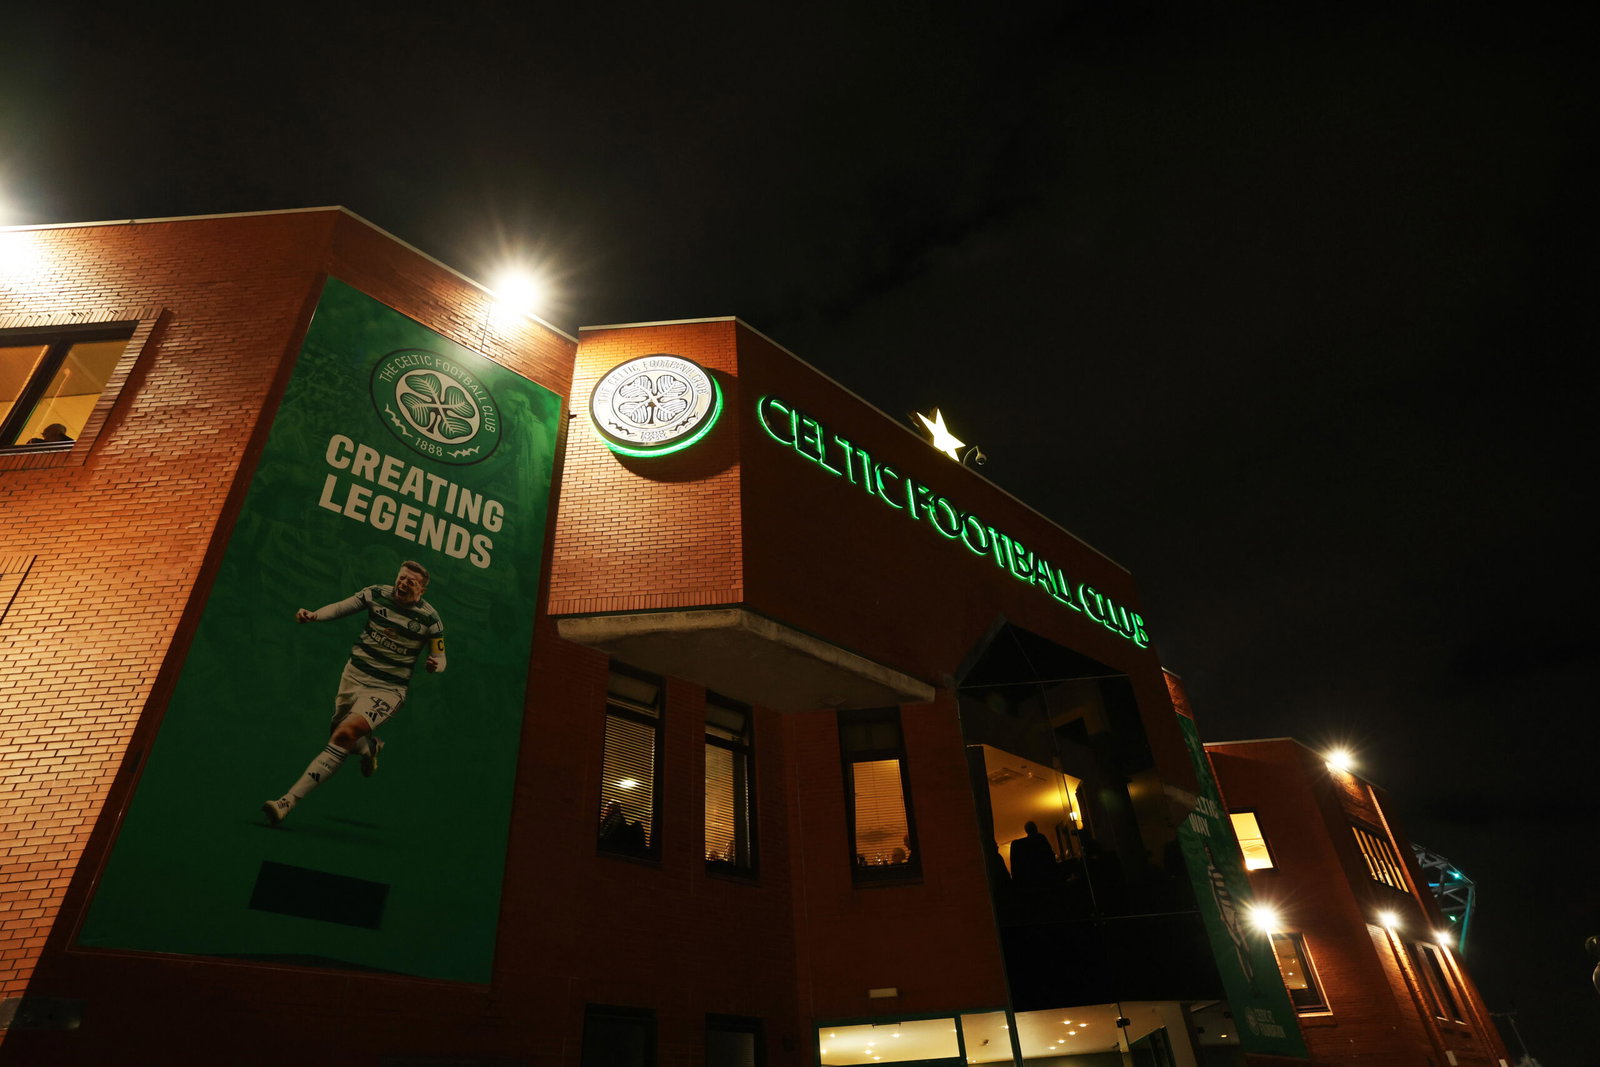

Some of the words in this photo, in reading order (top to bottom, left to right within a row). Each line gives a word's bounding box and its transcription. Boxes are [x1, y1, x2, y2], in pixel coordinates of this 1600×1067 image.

[379, 363, 399, 382] THE
[395, 354, 432, 369] CELTIC
[435, 359, 487, 403] FOOTBALL
[482, 405, 496, 433] CLUB
[415, 437, 443, 457] 1888
[640, 430, 667, 441] 1888
[318, 473, 494, 569] LEGENDS
[325, 433, 505, 533] CREATING
[756, 393, 904, 509] CELTIC
[905, 476, 1082, 613] FOOTBALL
[1077, 582, 1151, 649] CLUB
[370, 696, 392, 717] 42
